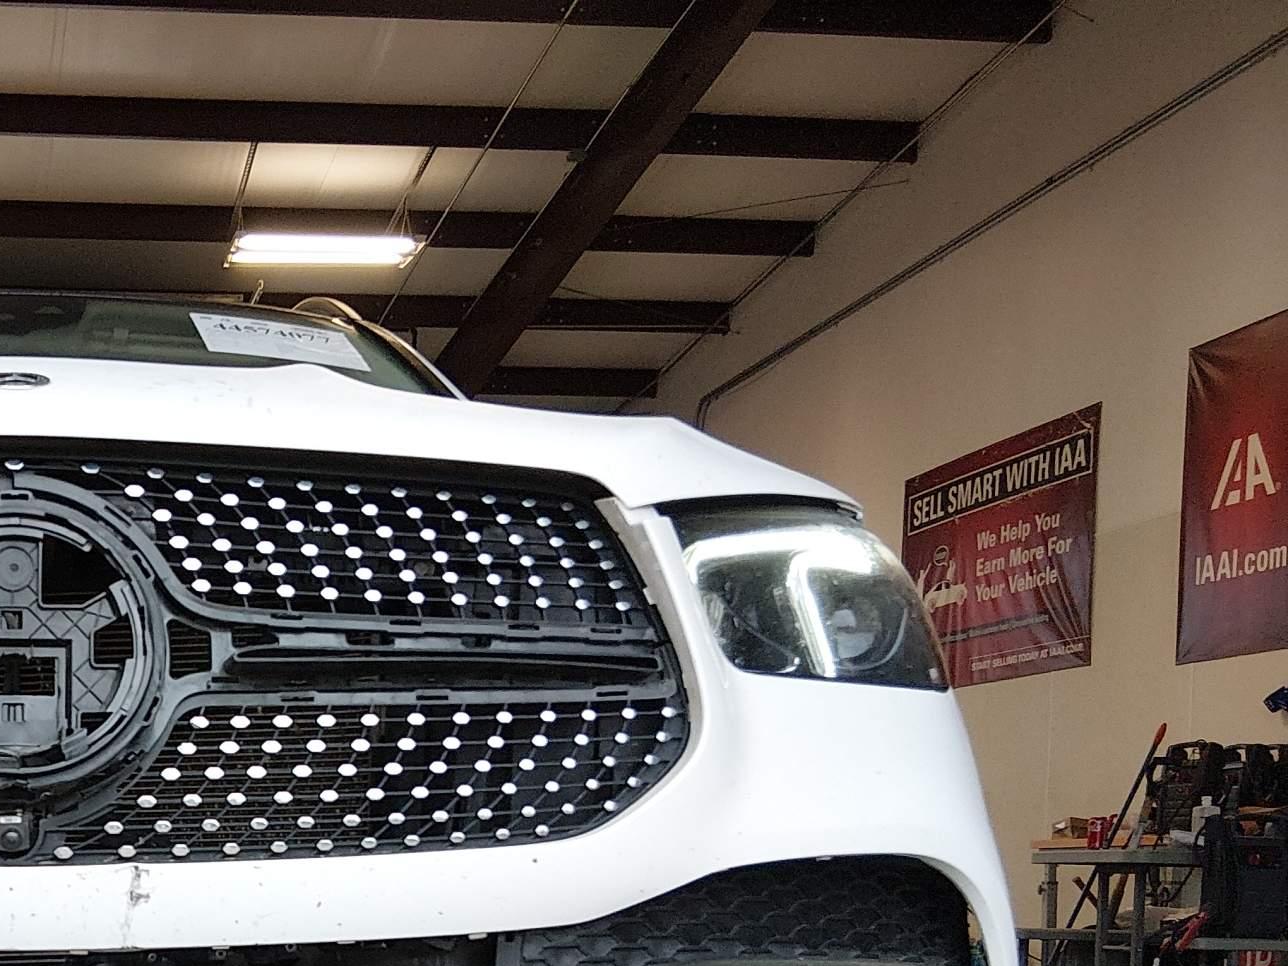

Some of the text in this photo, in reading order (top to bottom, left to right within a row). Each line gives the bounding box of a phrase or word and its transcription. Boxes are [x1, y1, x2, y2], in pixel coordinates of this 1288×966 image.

[213, 322, 331, 344] 44574077
[913, 438, 1087, 527] SELL SMART WITH IAA
[976, 512, 1060, 551] We Help You
[975, 536, 1073, 577] Earn More For
[1195, 545, 1288, 586] IAAI.com
[975, 566, 1058, 602] Your Vehicle
[971, 659, 991, 672] START
[991, 654, 1018, 669] SELLING
[1018, 651, 1039, 665] TODAY
